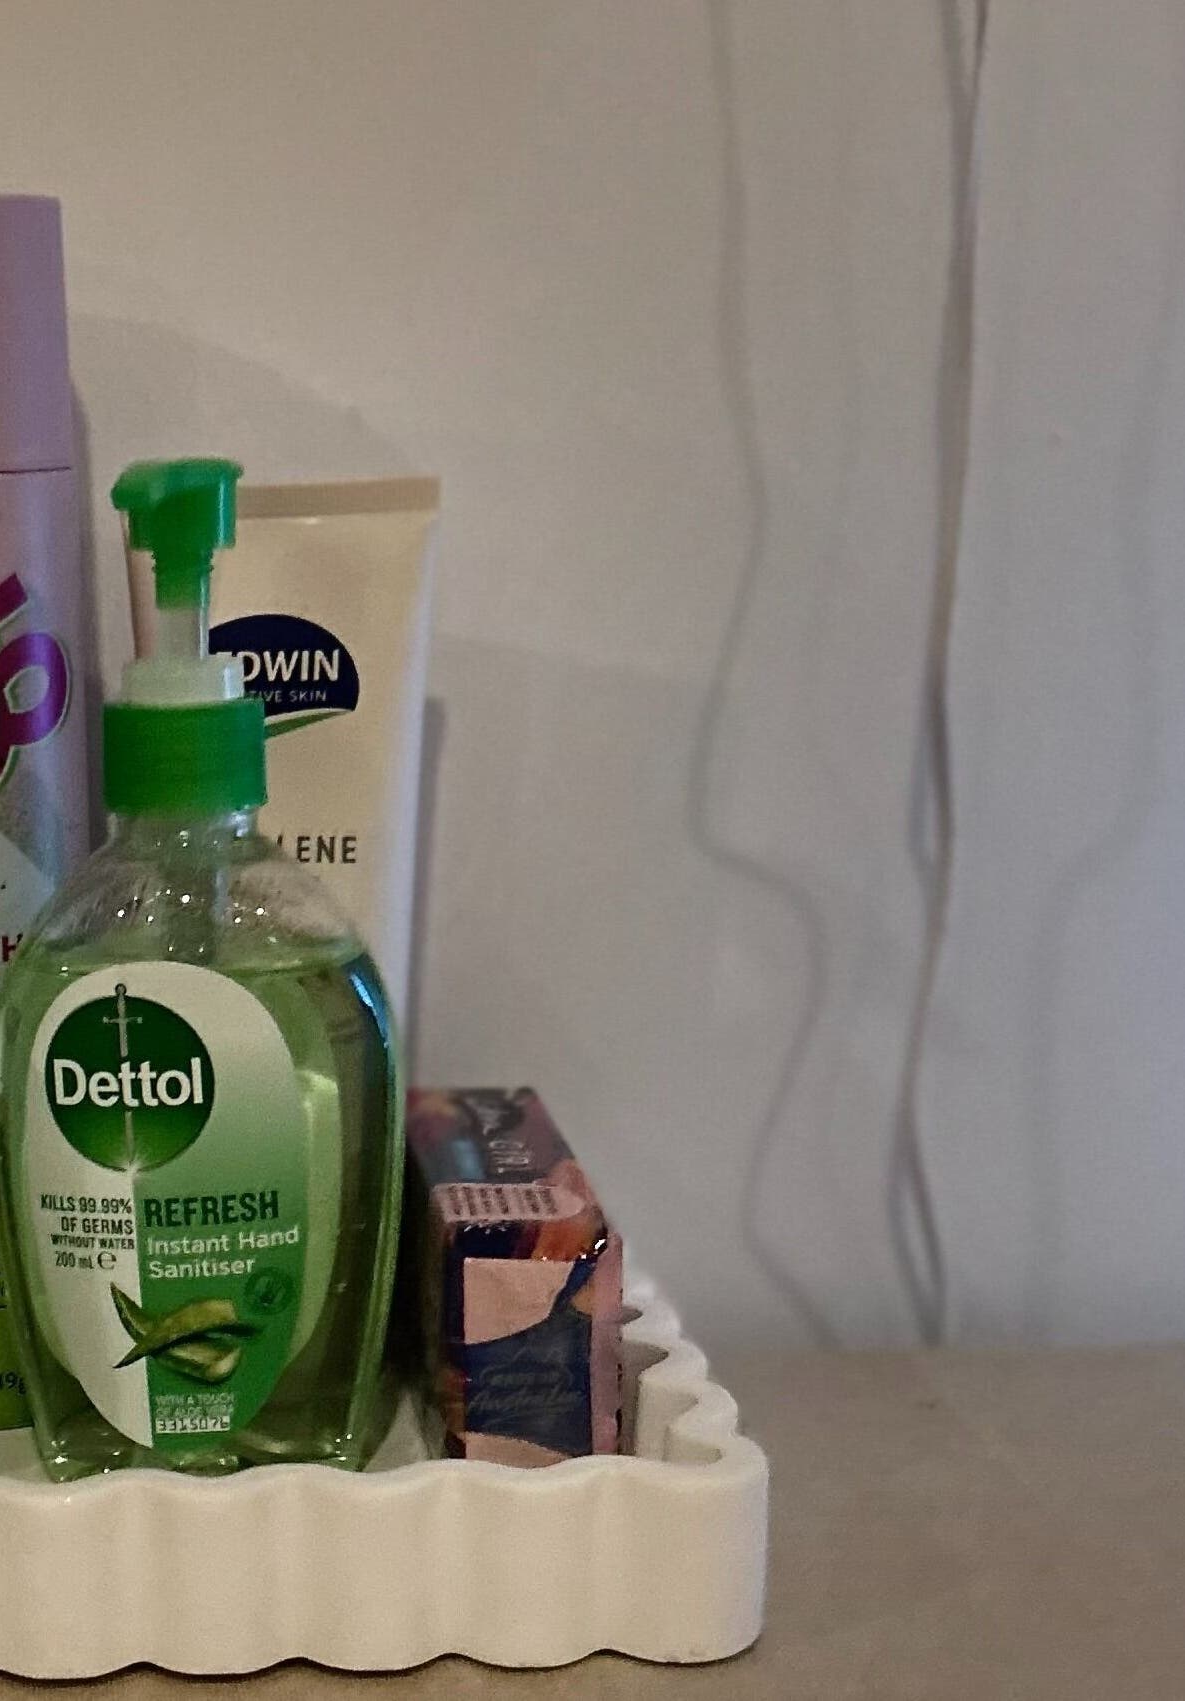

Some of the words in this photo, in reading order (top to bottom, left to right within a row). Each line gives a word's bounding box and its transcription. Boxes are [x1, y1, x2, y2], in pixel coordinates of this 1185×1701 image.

[216, 649, 340, 682] DWIN
[288, 687, 327, 702] SKIN
[278, 834, 357, 864] ENE
[54, 1056, 204, 1107] Dettol
[41, 1193, 75, 1211] KILLS
[79, 1197, 132, 1214] 99.99%
[143, 1191, 279, 1227] REFRESH
[61, 1216, 77, 1232] OF
[82, 1217, 133, 1235] GERMS
[51, 1233, 95, 1248] WITHOUT
[99, 1237, 135, 1250] WATER
[147, 1234, 230, 1256] Instant
[239, 1225, 299, 1250] Hand
[56, 1251, 76, 1268] 200
[149, 1257, 255, 1279] Sanitiser
